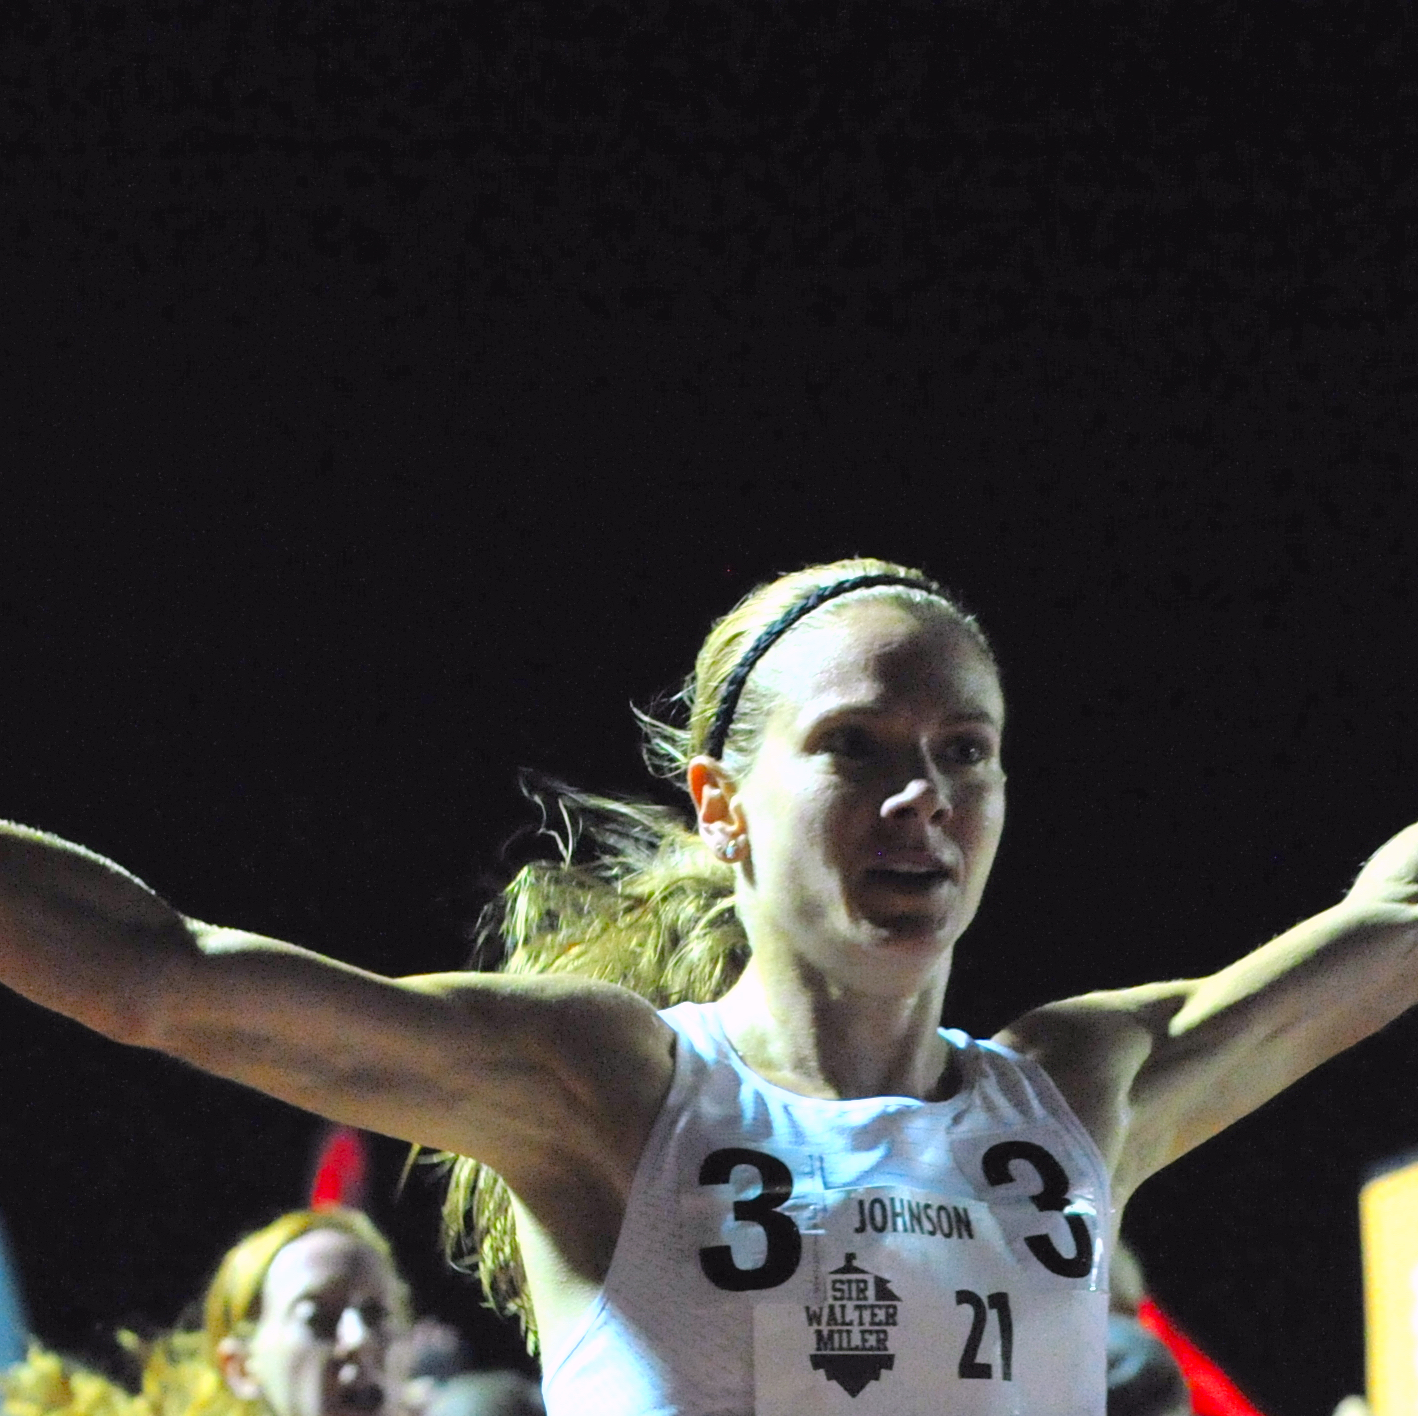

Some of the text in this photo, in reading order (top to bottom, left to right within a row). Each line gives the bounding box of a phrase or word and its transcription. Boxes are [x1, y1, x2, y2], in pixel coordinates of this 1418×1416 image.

[699, 1147, 802, 1292] 3
[854, 1197, 975, 1240] JOHNSON
[982, 1140, 1093, 1279] 3
[831, 1278, 869, 1301] SIR
[804, 1303, 898, 1327] WALTER
[955, 1289, 1014, 1382] 21
[814, 1328, 889, 1352] MILER
